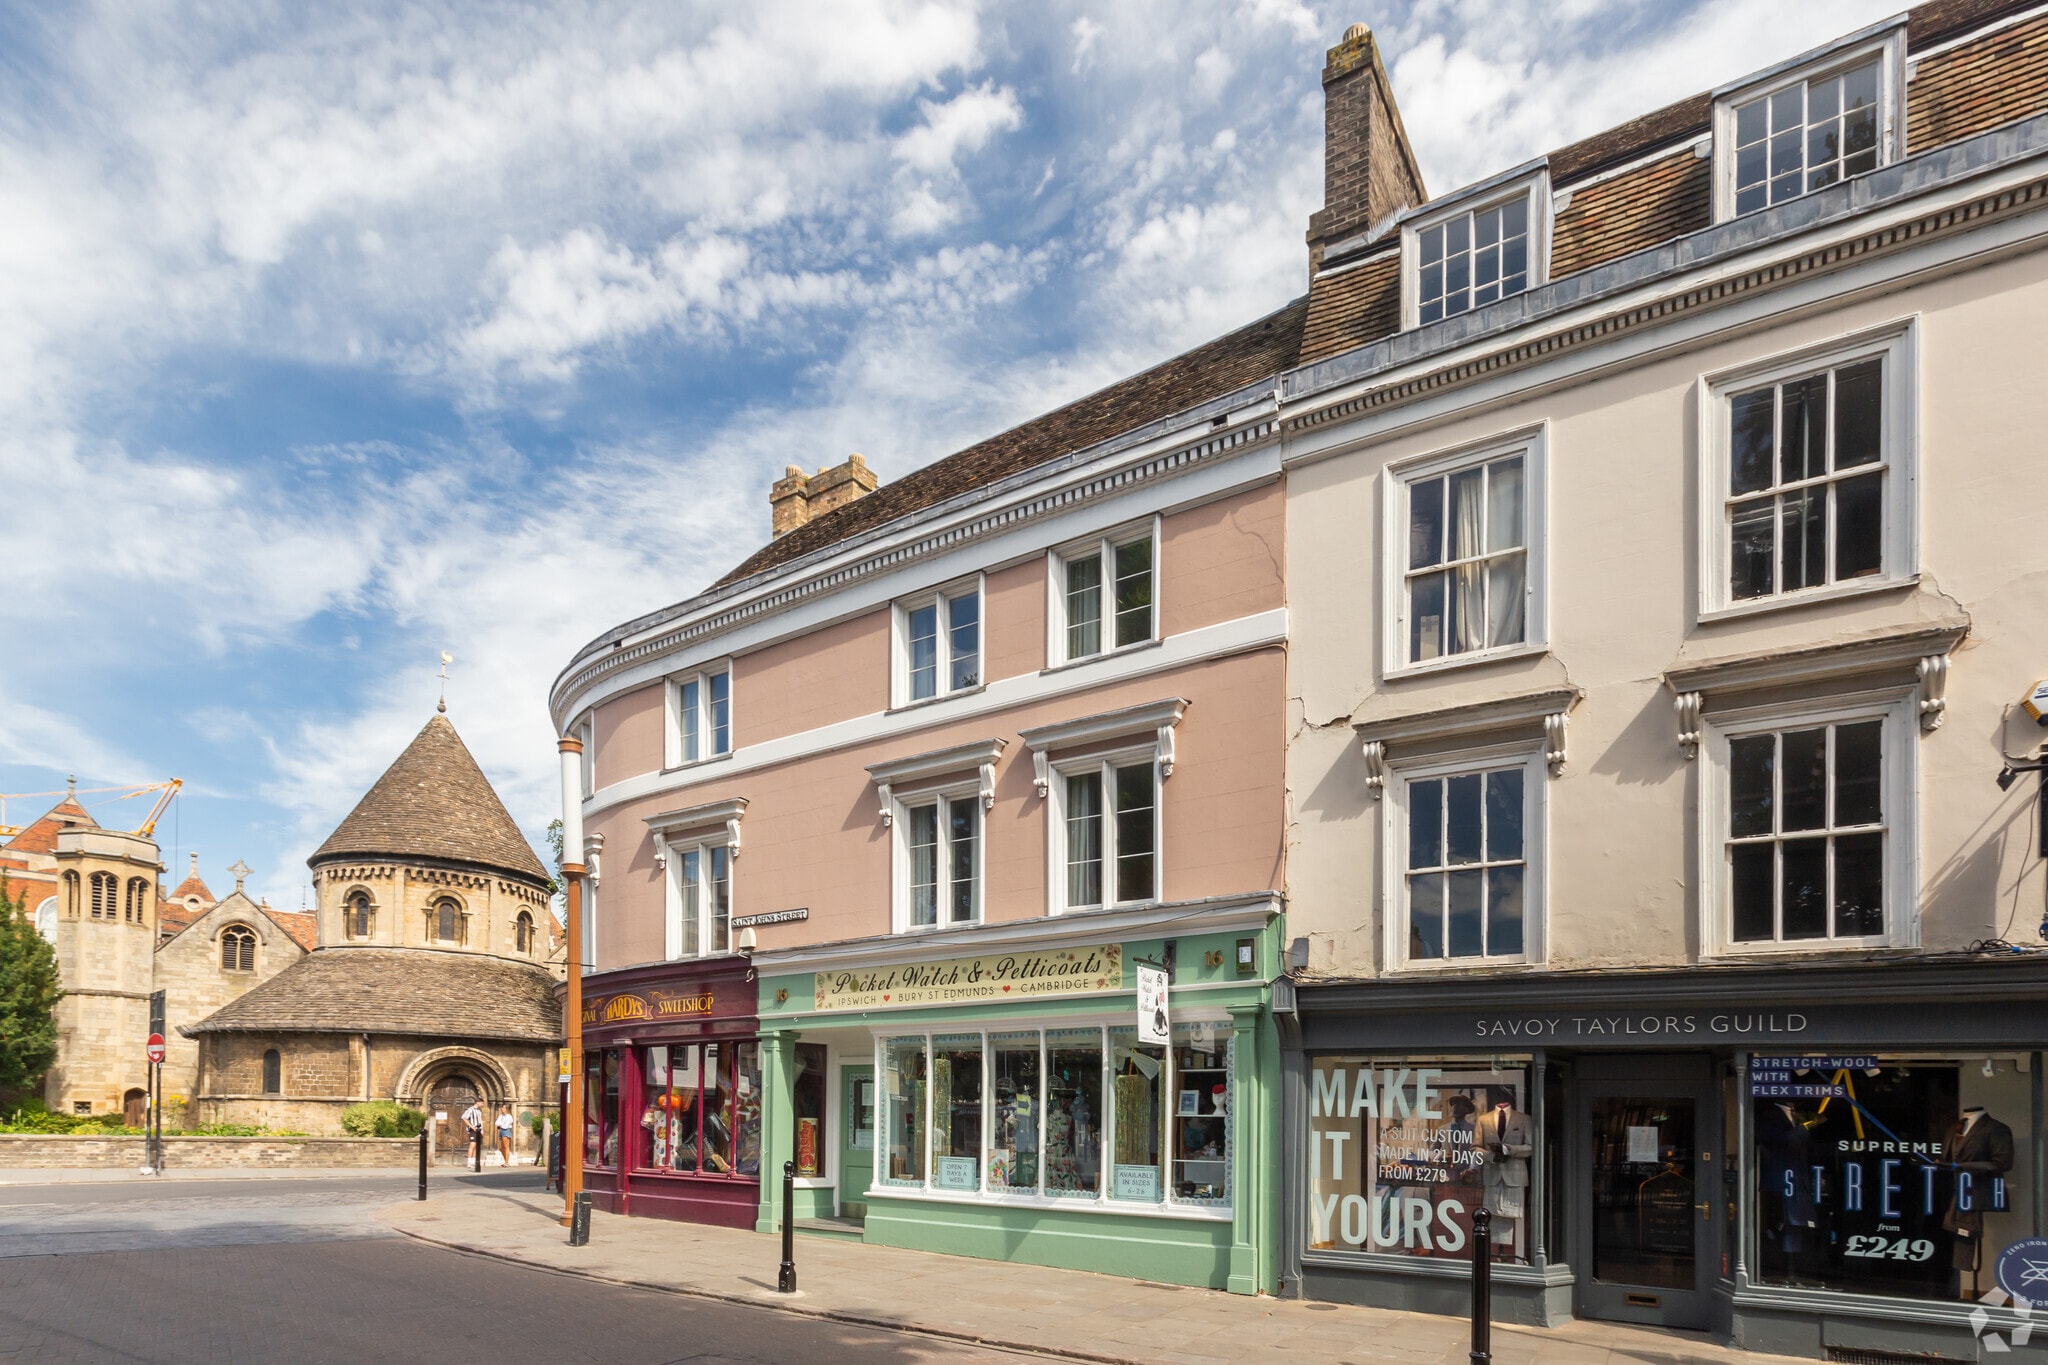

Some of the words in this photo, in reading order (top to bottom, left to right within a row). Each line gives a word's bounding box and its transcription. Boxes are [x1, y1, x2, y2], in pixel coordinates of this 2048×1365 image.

[731, 917, 753, 927] SAINT
[777, 911, 806, 921] STREET
[1205, 949, 1223, 967] 16
[902, 965, 959, 988] Watch
[967, 960, 983, 984] &
[992, 952, 1101, 981] Petticoats
[838, 995, 876, 1006] IPSWICH
[898, 991, 924, 1002] BURY
[928, 990, 939, 999] ST
[944, 986, 994, 999] EDMUNDS
[1021, 979, 1089, 993] CAMBRIDGE
[607, 997, 643, 1019] HARDYS
[659, 996, 714, 1015] SWEETSHOP
[1476, 1018, 1561, 1036] SAVOY
[1572, 1015, 1697, 1035] TAYLORS
[1710, 1014, 1807, 1033] GUILD
[1752, 1058, 1876, 1068] STRETCH-WOOL
[1752, 1072, 1789, 1081] WITH
[1312, 1068, 1442, 1120] MAKE
[1752, 1086, 1789, 1095] FLEX
[1795, 1086, 1844, 1096] TRIMS
[1380, 1128, 1388, 1139] A
[1391, 1128, 1417, 1142] SUIT
[1421, 1129, 1473, 1144] CUSTOM
[1312, 1130, 1350, 1181] IT
[1379, 1146, 1412, 1161] MADE
[1417, 1148, 1429, 1162] IN
[1433, 1149, 1447, 1163] 21
[1452, 1150, 1484, 1165] DAYS
[1838, 1140, 1943, 1155] SUPREME
[1379, 1164, 1413, 1180] FROM
[1416, 1168, 1448, 1183] £279
[1784, 1158, 2005, 1219] STRETCH
[1313, 1193, 1466, 1252] YOURS
[1877, 1222, 1900, 1232] from
[1844, 1234, 1935, 1262] £249
[2006, 1243, 2025, 1256] ZERO
